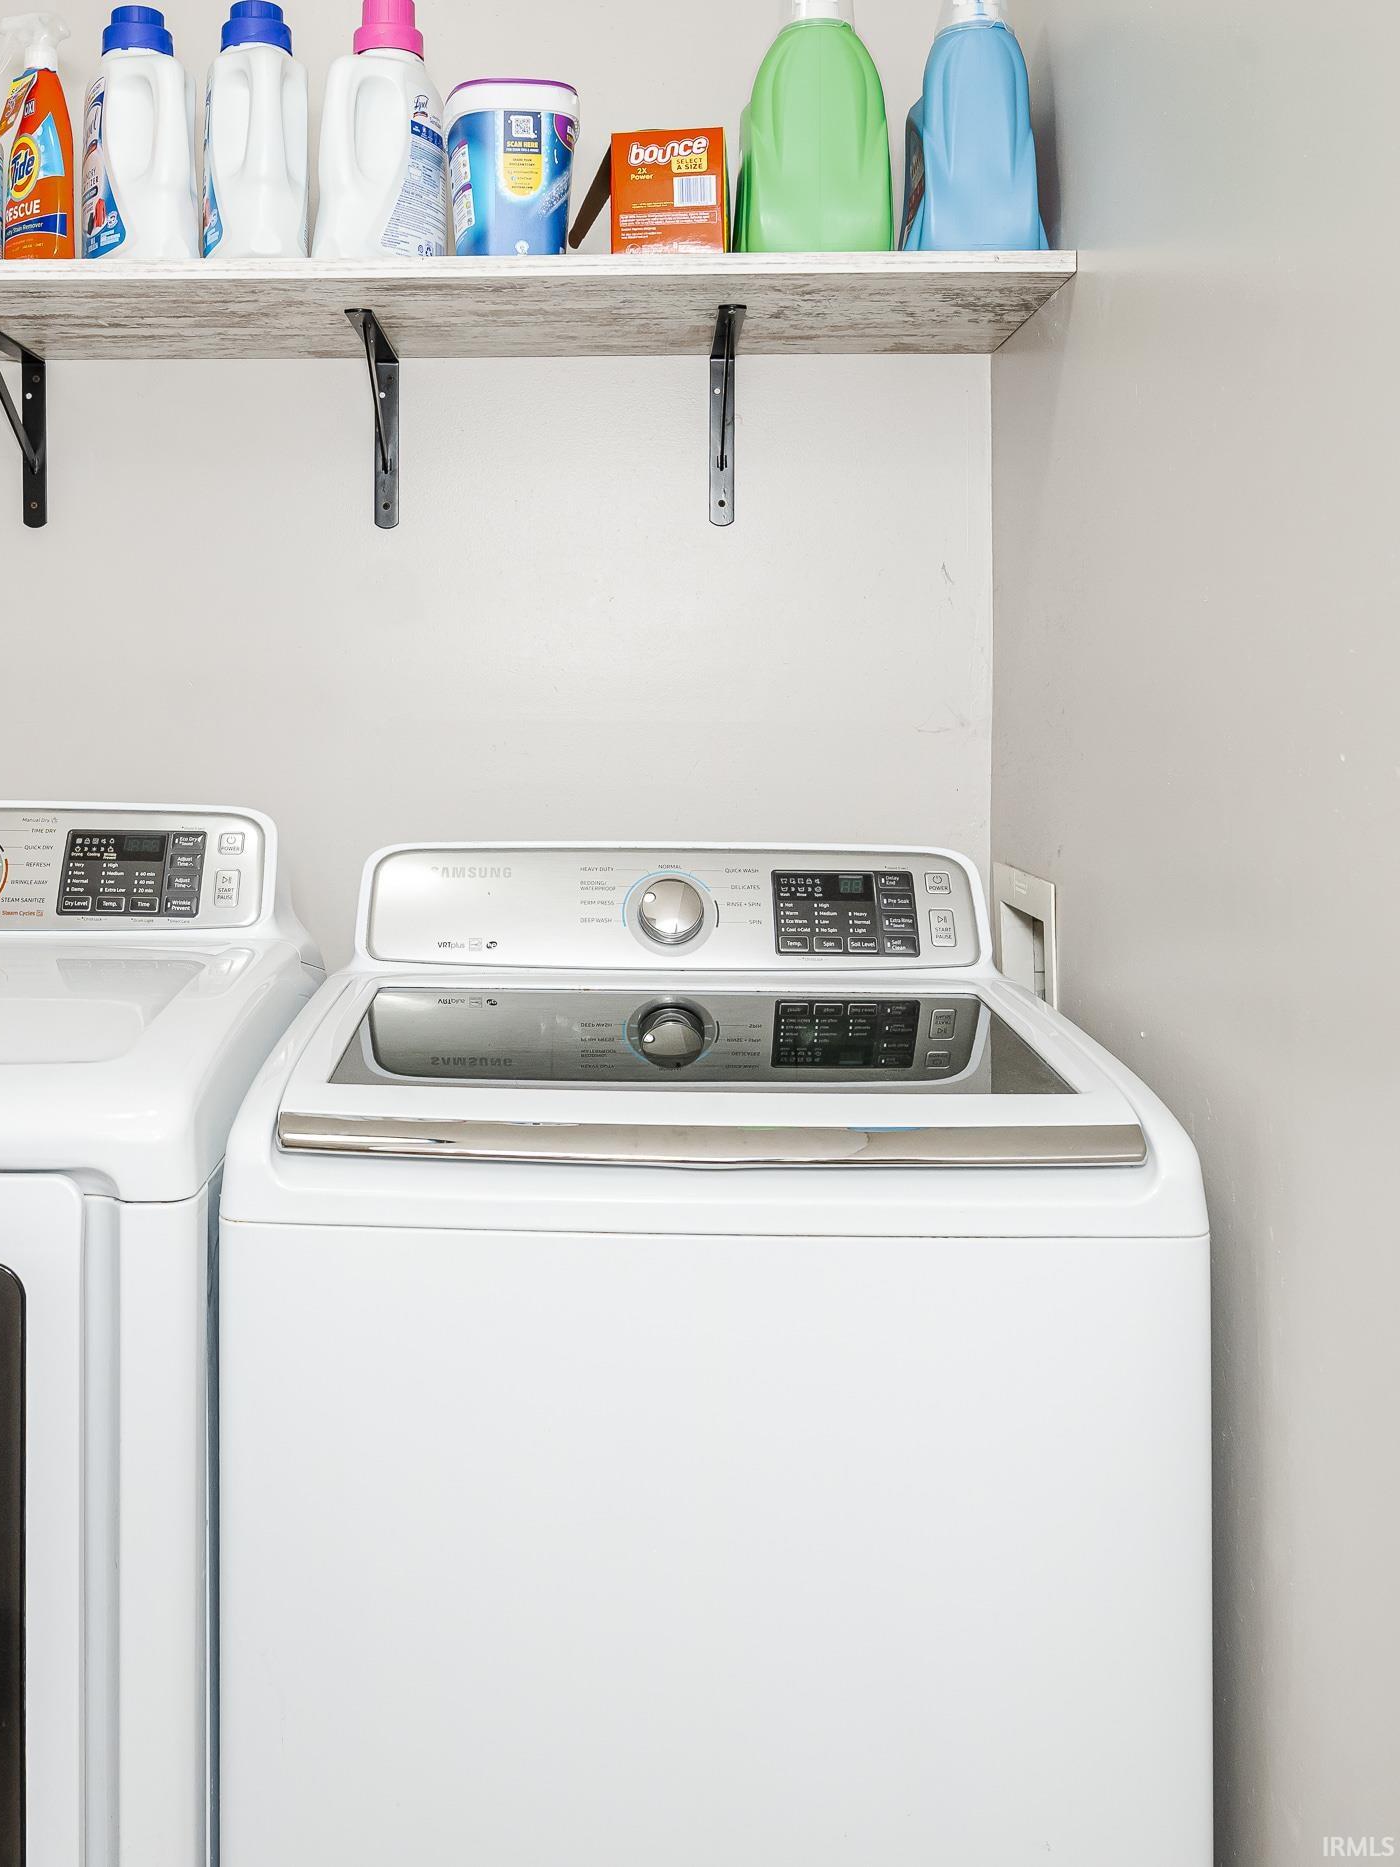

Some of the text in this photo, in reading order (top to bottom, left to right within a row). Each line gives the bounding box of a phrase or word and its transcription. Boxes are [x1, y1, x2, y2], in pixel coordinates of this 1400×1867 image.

[630, 137, 708, 165] bounce
[11, 149, 36, 189] Tide
[23, 222, 44, 230] Remover
